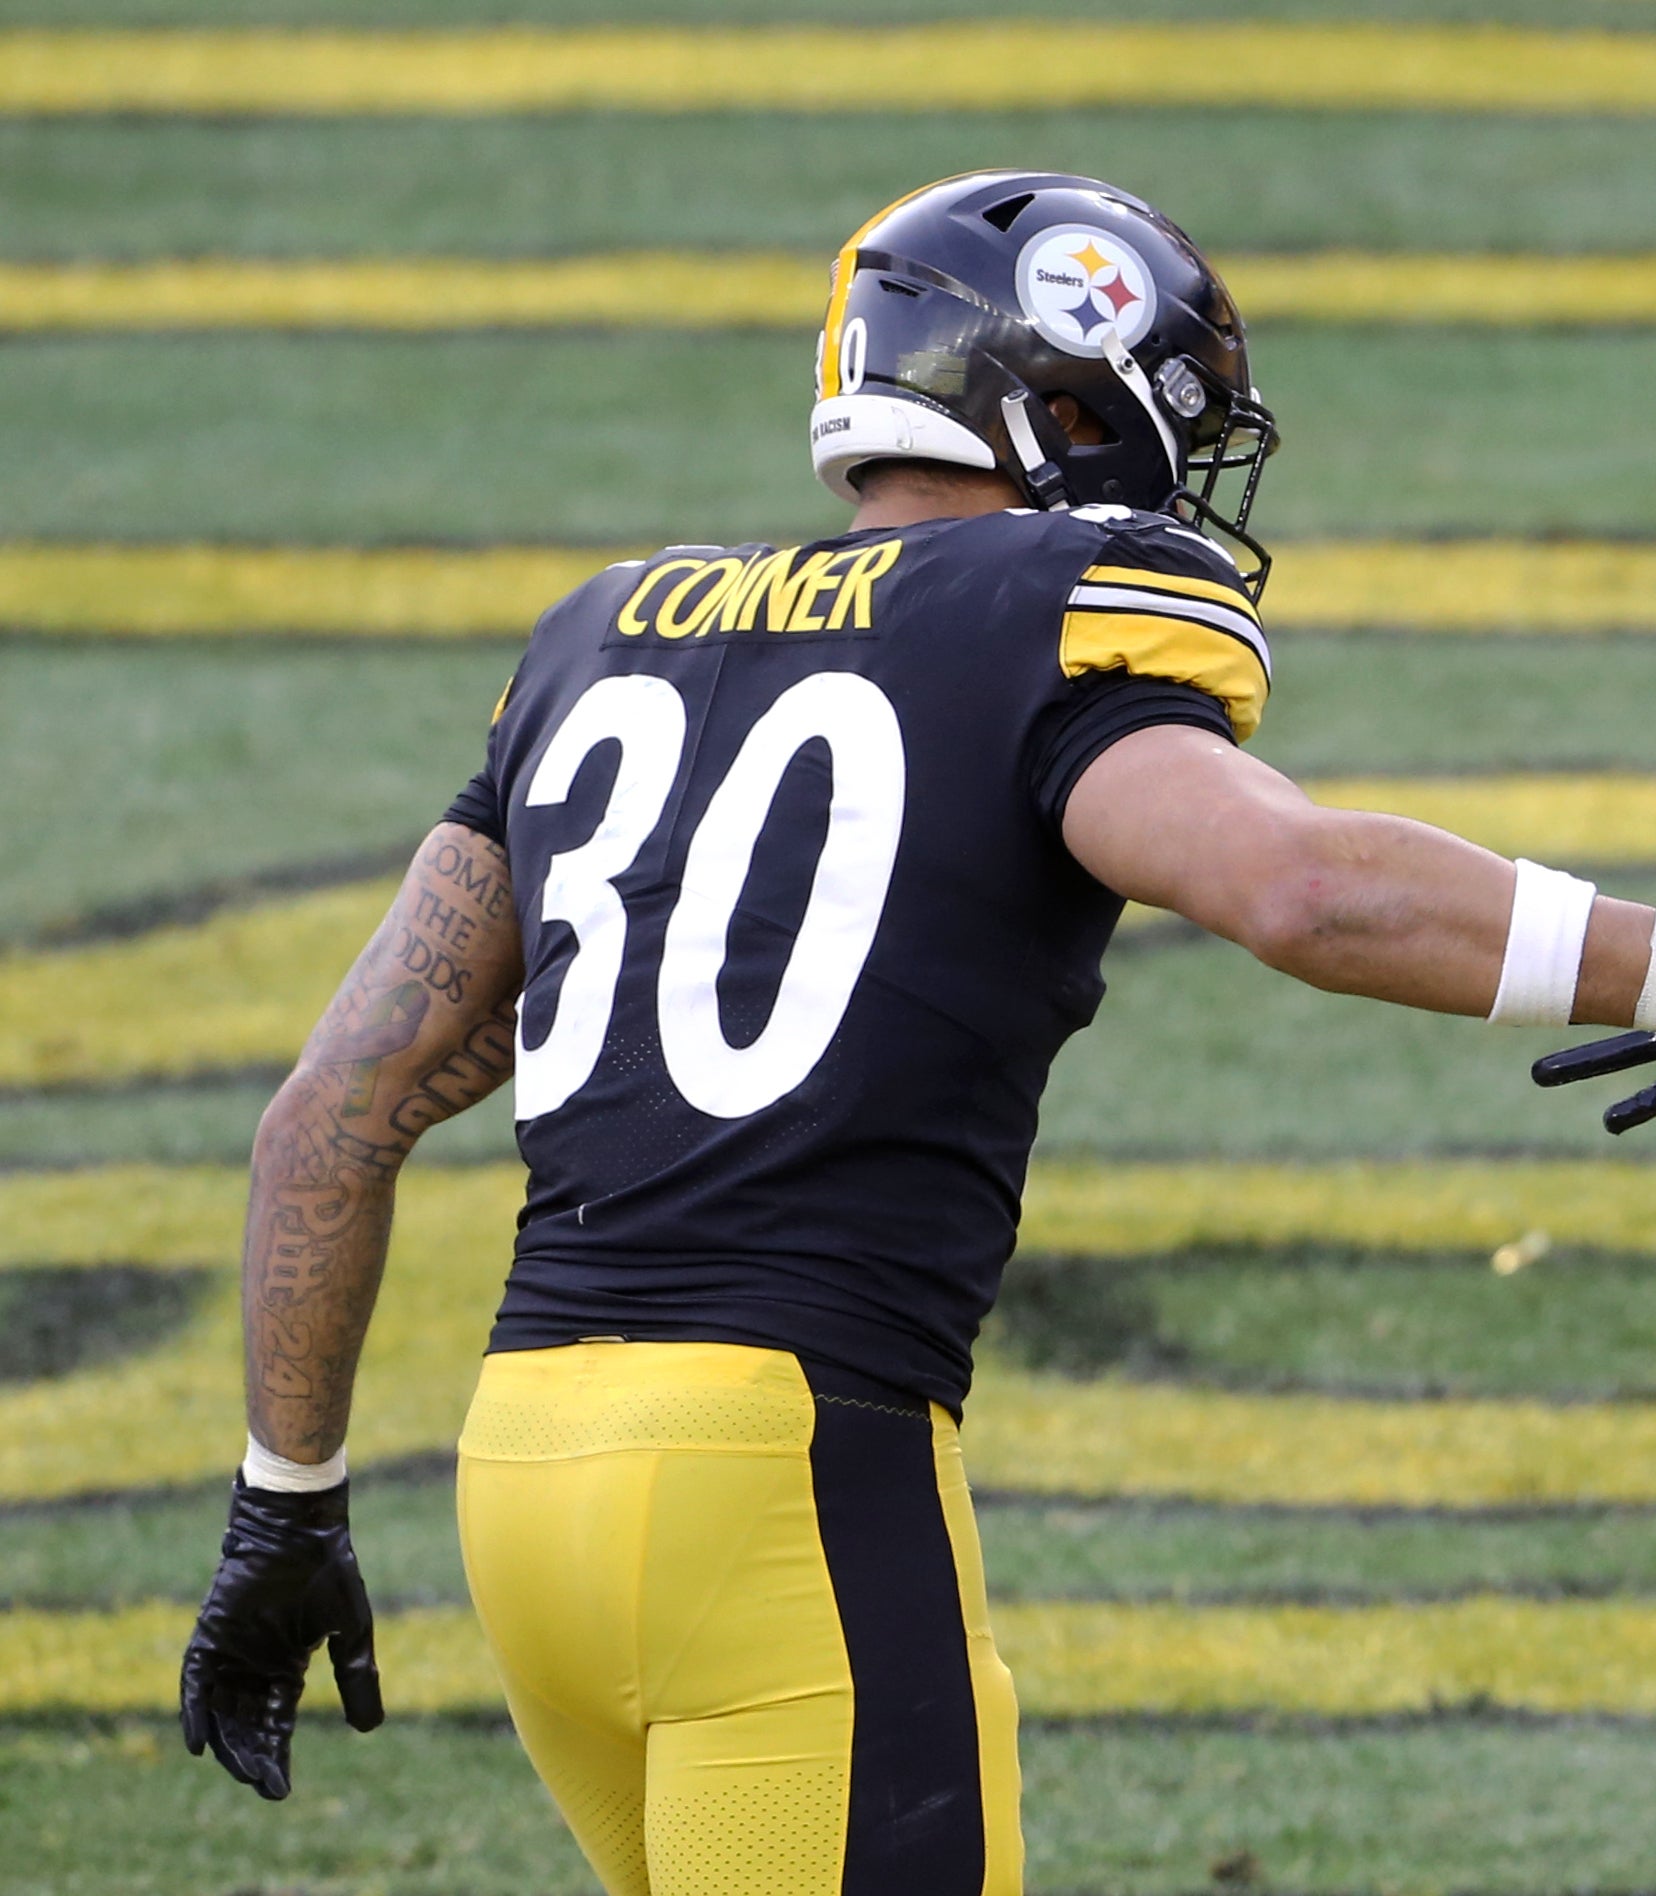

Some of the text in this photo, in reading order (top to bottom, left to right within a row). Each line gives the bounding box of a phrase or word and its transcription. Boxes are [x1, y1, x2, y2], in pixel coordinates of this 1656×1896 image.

[1036, 268, 1084, 288] Steelers
[617, 539, 903, 639] CONNER
[415, 887, 477, 951] THE
[514, 671, 907, 1121] 30
[262, 1306, 314, 1399] 24
